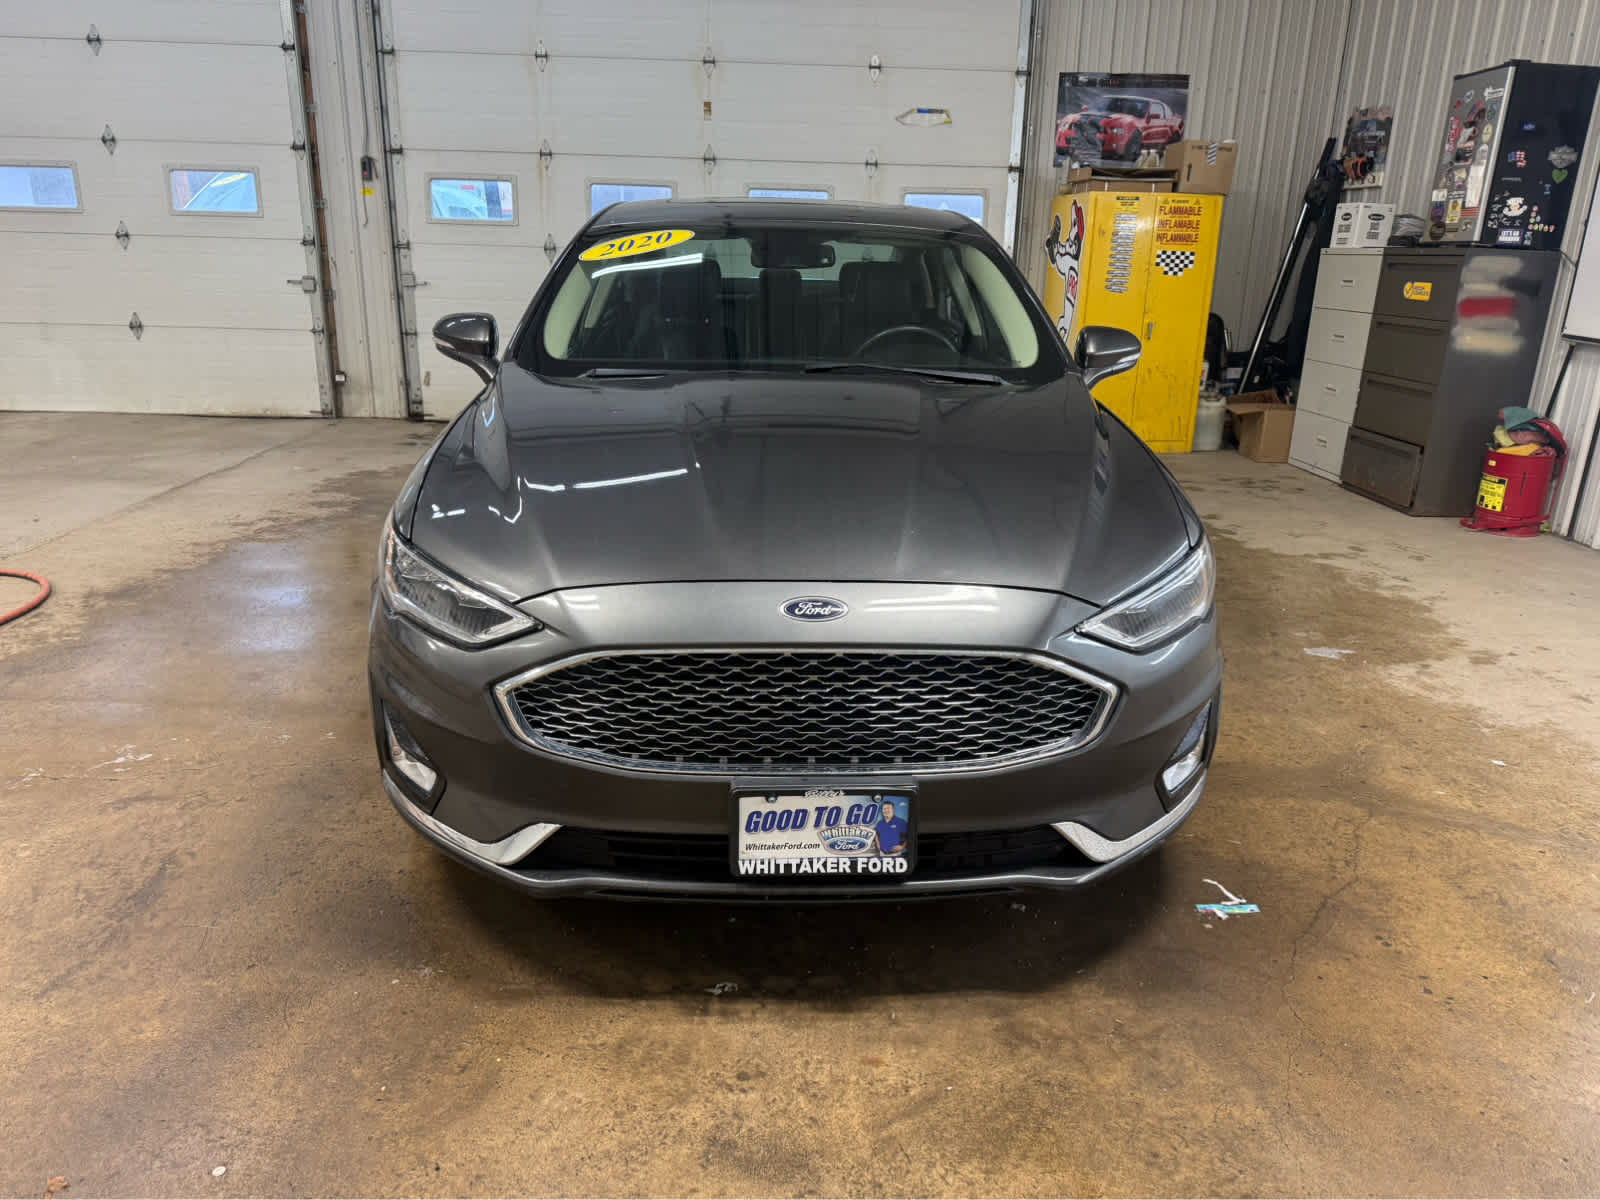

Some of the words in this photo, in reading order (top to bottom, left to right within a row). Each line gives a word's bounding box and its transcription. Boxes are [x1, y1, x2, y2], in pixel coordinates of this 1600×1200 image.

[1159, 205, 1203, 216] FLAMMABLE
[600, 232, 673, 257] 2020
[794, 601, 833, 615] Ford
[745, 809, 808, 833] GOOD
[813, 806, 842, 828] TO
[845, 803, 879, 827] GO
[821, 827, 873, 841] Whittaker
[745, 842, 821, 851] WhittakerFord.com
[834, 840, 860, 850] Ford
[738, 857, 851, 875] WHITTAKER
[857, 857, 908, 873] FORD
